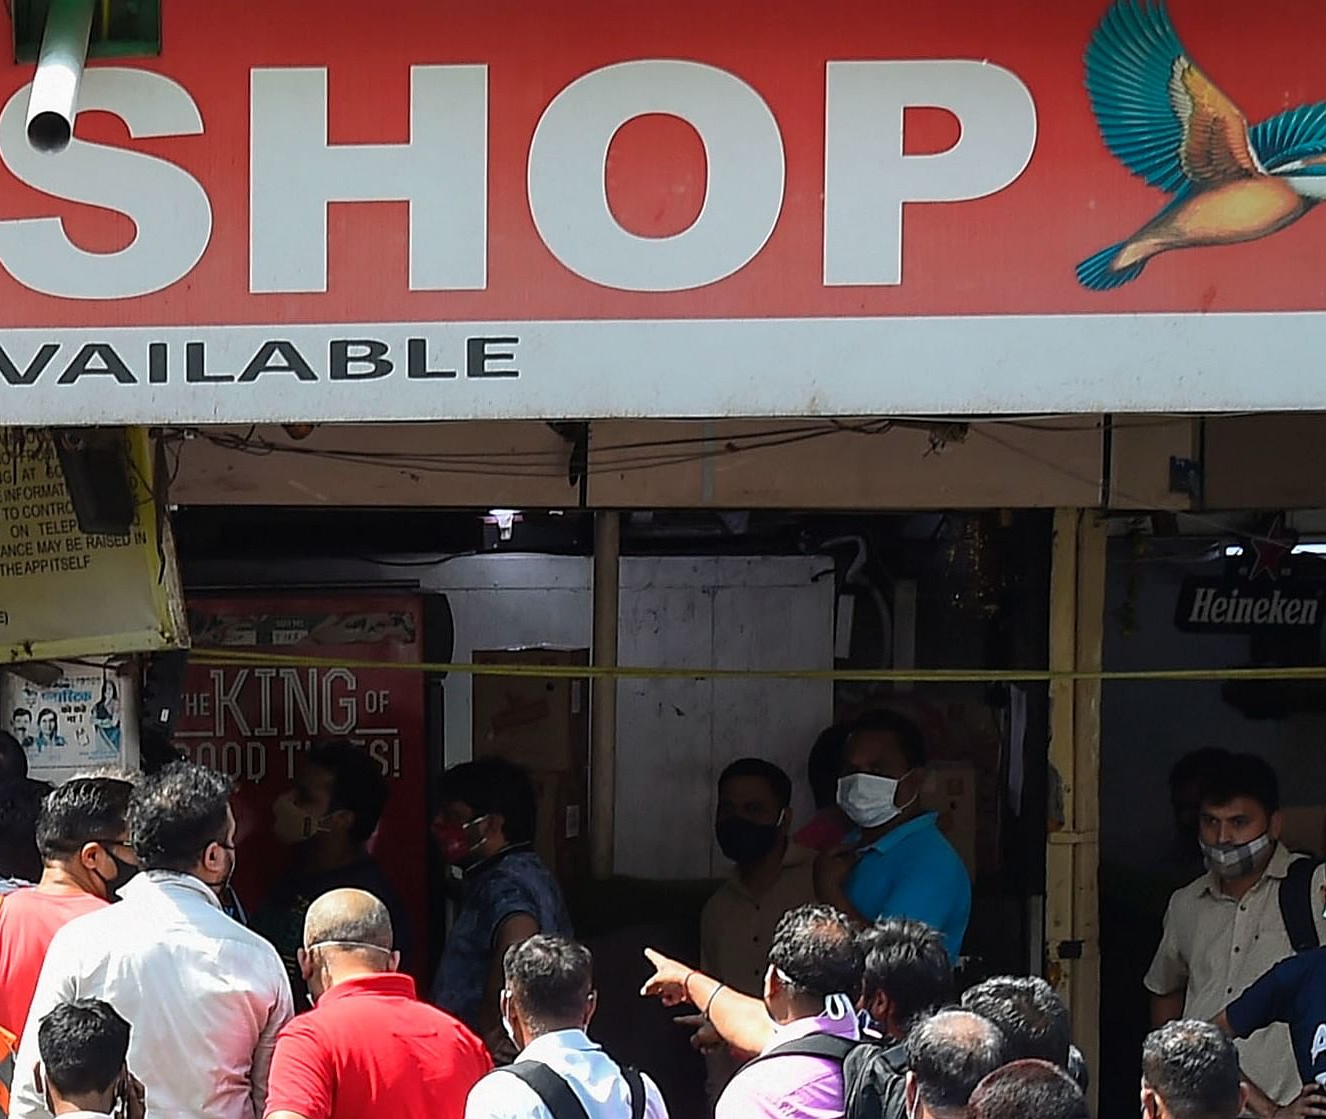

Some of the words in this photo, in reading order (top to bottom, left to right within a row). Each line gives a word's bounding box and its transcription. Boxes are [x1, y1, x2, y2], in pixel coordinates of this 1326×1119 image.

[22, 467, 36, 481] AT
[5, 482, 66, 501] INFORMAT
[4, 506, 19, 521] TO
[22, 502, 74, 517] CONTRO
[10, 524, 29, 539] ON
[39, 519, 77, 536] TELEP
[36, 541, 61, 554] MAY
[66, 537, 83, 551] BE
[86, 535, 130, 550] RAISED
[135, 531, 146, 545] IN
[0, 561, 22, 577] THE
[24, 559, 48, 574] APP
[50, 554, 91, 572] ITSELF
[1188, 588, 1319, 625] Heineken
[181, 693, 210, 716] HE
[210, 667, 357, 737] KING
[364, 690, 390, 714] OF
